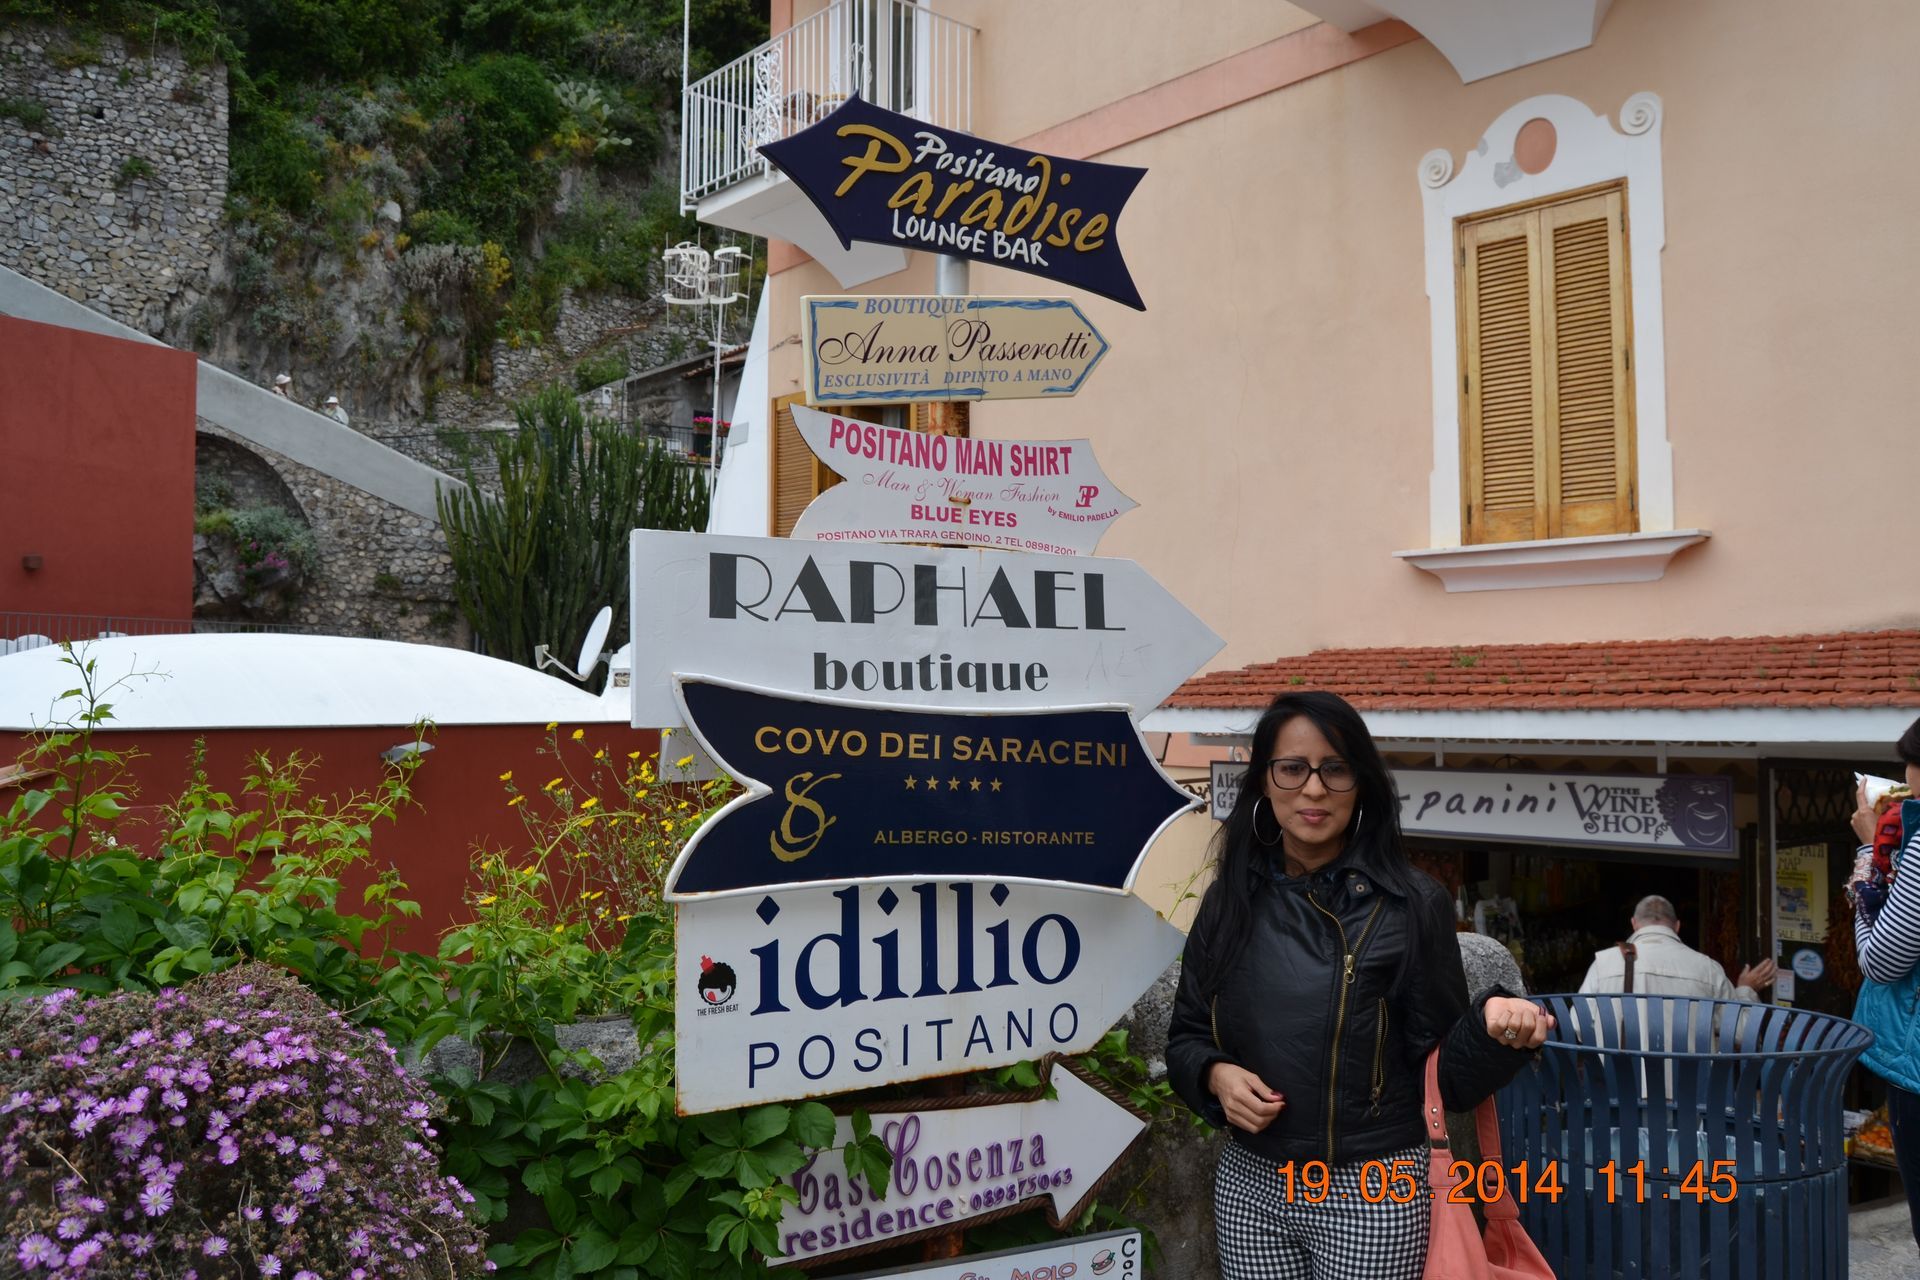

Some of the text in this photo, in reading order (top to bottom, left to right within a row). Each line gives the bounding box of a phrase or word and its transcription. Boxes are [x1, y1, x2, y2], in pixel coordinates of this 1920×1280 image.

[913, 131, 1041, 193] Positano
[834, 123, 1110, 252] Paradise
[892, 210, 1048, 267] LOUNGE BAR
[864, 298, 969, 318] BOUTIQUE
[818, 319, 1092, 365] Anna Passerotti
[824, 368, 1073, 388] ESCLUSIVITÀ DIPINTO A MANO
[829, 418, 1072, 477] POSITANO MAN SHIRT
[862, 470, 911, 492] Man
[937, 477, 993, 501] Woman
[1000, 483, 1060, 502] Fashion
[911, 504, 1017, 528] BLUE EYES
[1047, 506, 1119, 523] by EMILIO PADELLA
[817, 529, 876, 541] POSITANO
[878, 530, 899, 539] VIA
[900, 529, 938, 540] TRARA
[995, 536, 1002, 544] 2
[1004, 536, 1023, 547] TEL
[709, 551, 1126, 631] RAPHAEL
[814, 652, 1049, 693] boutique
[754, 726, 1128, 767] COVO DEI SARACENI
[1565, 782, 1656, 821] WINE
[1610, 786, 1641, 795] THE
[873, 830, 968, 846] ALBERGO
[981, 830, 1095, 846] RISTORANTE
[1583, 811, 1657, 835] SHOP
[749, 882, 1081, 1017] idillio
[697, 1004, 739, 1016] THE FRESH BEAT
[748, 1002, 1080, 1089] POSITANO
[882, 1113, 1047, 1196] Cosenza
[785, 1197, 955, 1258] residence
